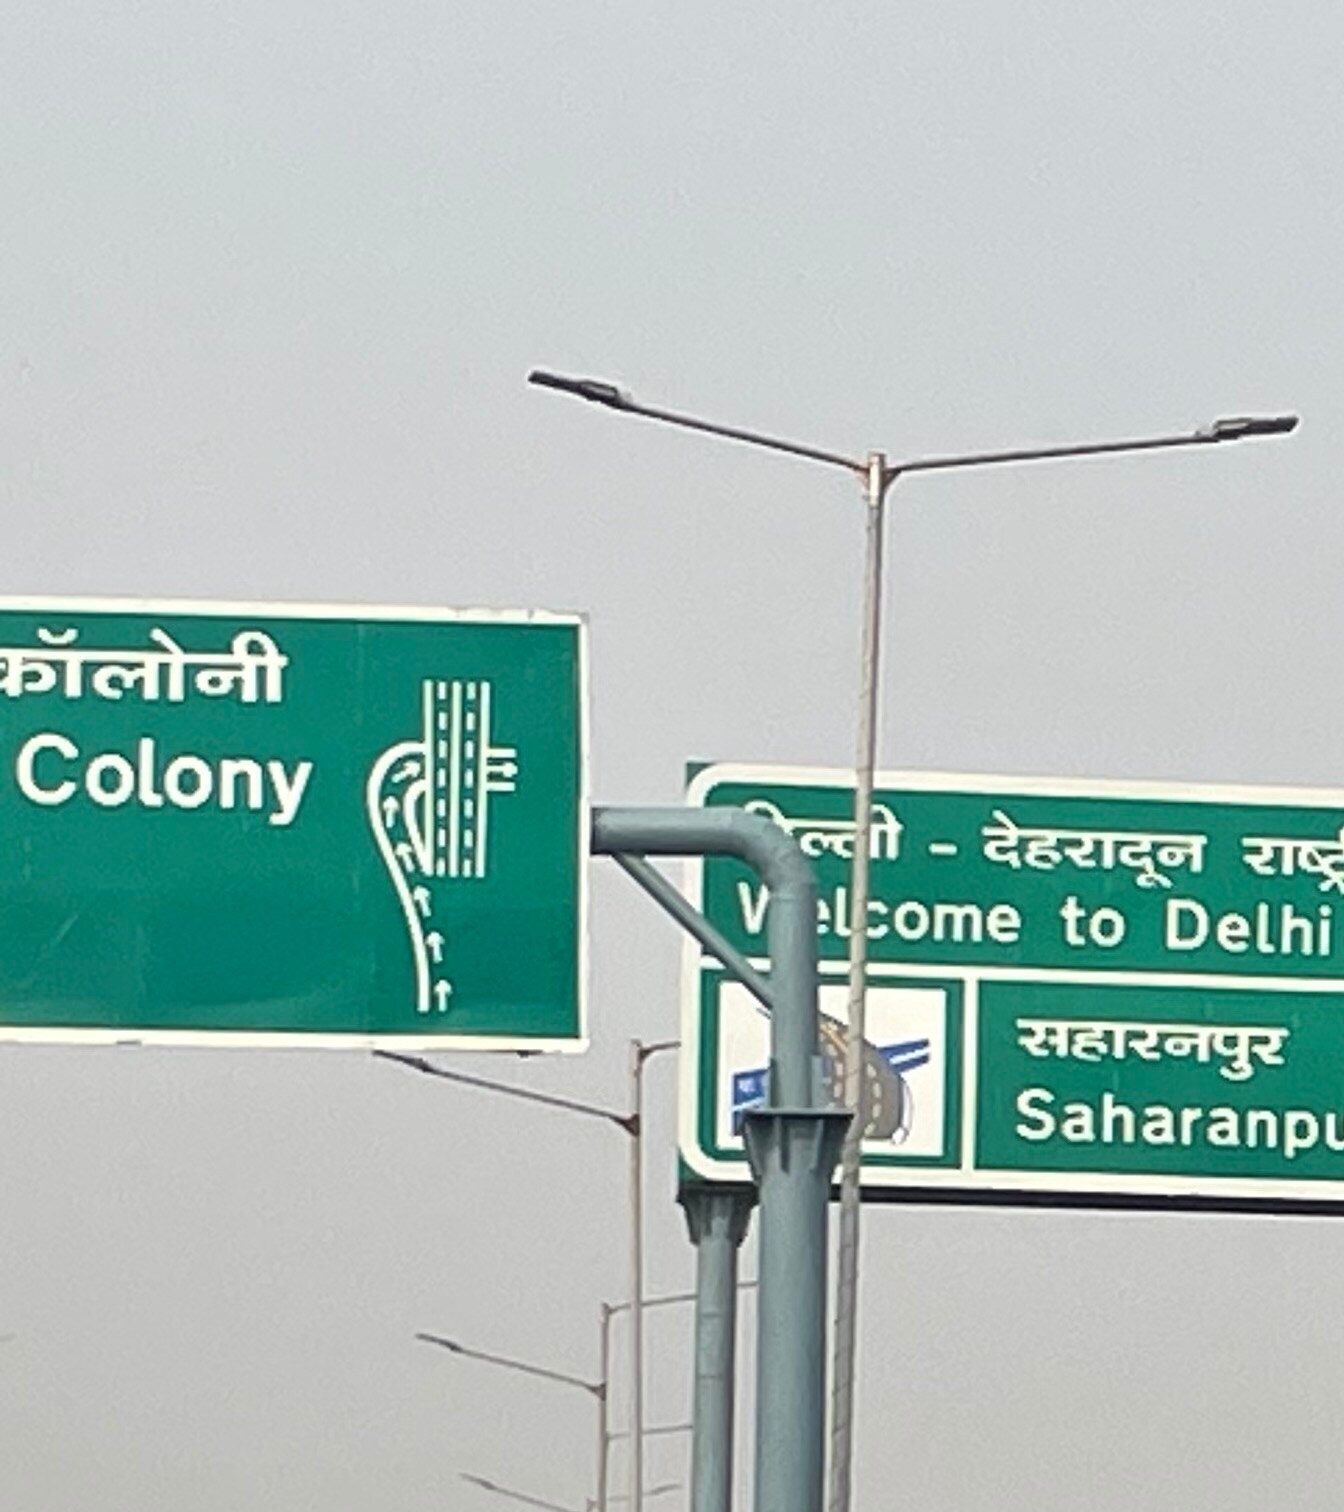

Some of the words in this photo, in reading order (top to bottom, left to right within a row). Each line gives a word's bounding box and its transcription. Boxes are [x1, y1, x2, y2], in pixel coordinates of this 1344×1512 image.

[16, 733, 314, 825] Colony
[982, 810, 1206, 887] देहरादून
[1060, 896, 1126, 948] to
[1165, 899, 1332, 957] Delhi
[1016, 1017, 1288, 1080] सहारनपुर
